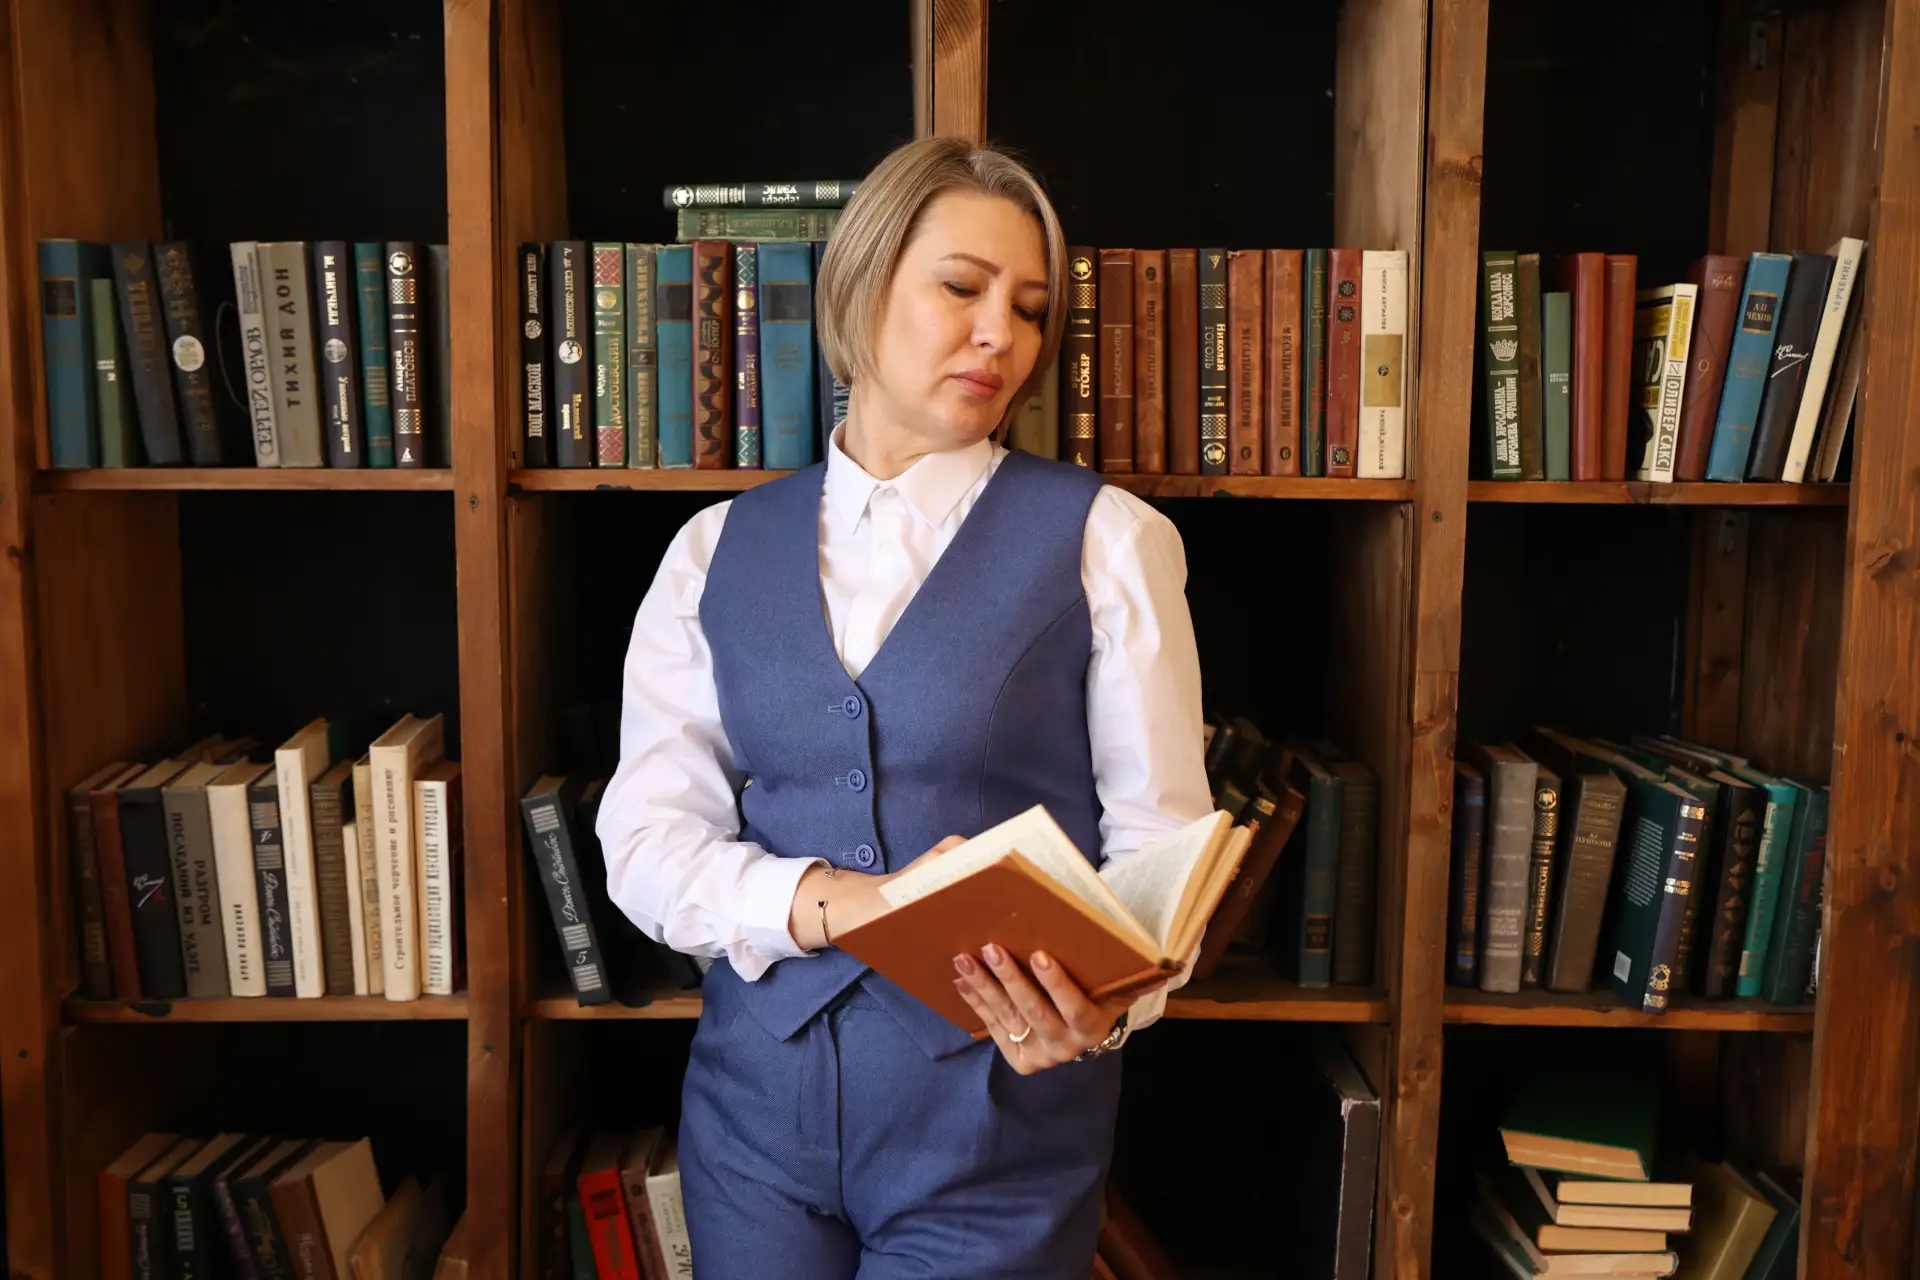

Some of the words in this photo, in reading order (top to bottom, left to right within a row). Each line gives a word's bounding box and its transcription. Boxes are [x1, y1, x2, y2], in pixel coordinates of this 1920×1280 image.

[323, 255, 335, 269] М.
[564, 247, 573, 256] А.
[274, 268, 296, 315] ДОН
[325, 271, 340, 326] МИТЧЕЛЛ
[1490, 272, 1502, 291] ПАЛ
[1502, 273, 1514, 318] ХЕРСОНЕС
[1832, 259, 1852, 313] ЧЕРЧЕНИЕ
[1491, 292, 1503, 321] КОГДА
[1747, 311, 1771, 321] ЧЕХОВ
[246, 327, 265, 385] ОРЛОВ
[278, 328, 301, 409] ТИХИЙ
[1204, 326, 1215, 369] ГОГОЛЬ
[1216, 323, 1226, 372] Николай
[1697, 359, 1710, 381] 9
[394, 350, 404, 393] Андрей
[404, 340, 416, 402] ПЛАТОНОВ
[526, 362, 542, 412] МАСКОЙ
[606, 337, 622, 425] ДОСТОЕВСКИЙ
[1080, 353, 1090, 398] СТОКЕР
[1505, 377, 1517, 420] ФРАНЦИИ
[1662, 380, 1680, 431] ОЛИВЕР
[250, 388, 275, 456] СЕРГЕЙ
[528, 413, 544, 438] ПОД
[1507, 422, 1519, 466] КОРОЛЕВА
[1496, 438, 1508, 462] АННА
[1657, 434, 1673, 467] САКС
[384, 768, 398, 823] рисование
[423, 788, 438, 838] РУКОДЕЛИЙ
[171, 812, 193, 898] ПОСЛЕДНИЙ
[388, 838, 401, 890] черчение
[425, 843, 439, 880] ЖЕНСКИХ
[183, 906, 195, 925] ИЗ
[194, 860, 212, 926] РАЗГРОМ
[392, 894, 405, 970] Строительное
[426, 885, 442, 950] ЭНЦИКЛОПЕДИЯ
[184, 932, 201, 974] УДЭГЕ
[576, 950, 588, 965] 5
